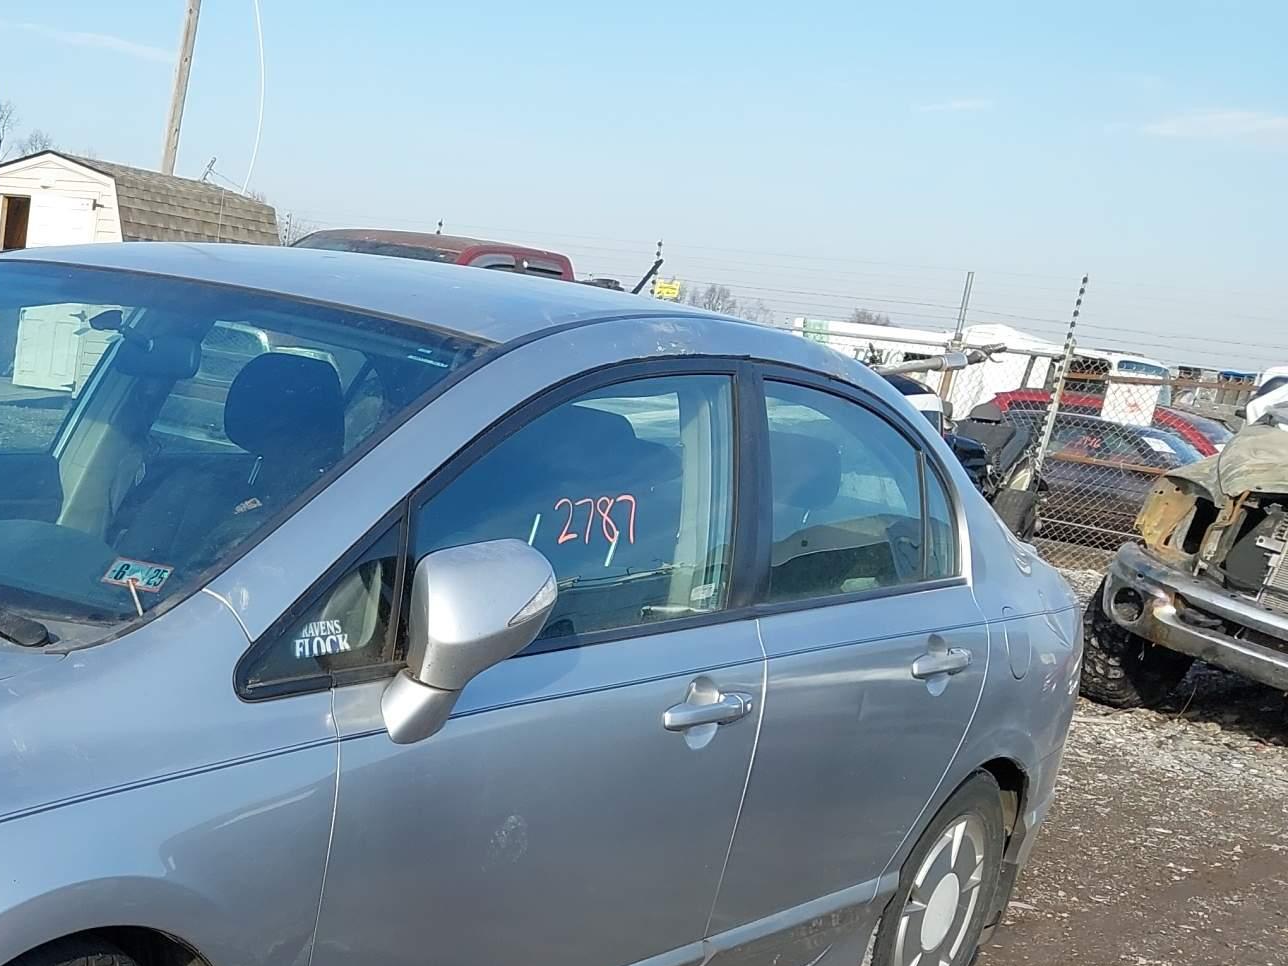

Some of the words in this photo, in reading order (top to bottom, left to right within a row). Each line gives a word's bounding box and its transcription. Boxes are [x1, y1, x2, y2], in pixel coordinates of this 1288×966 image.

[554, 494, 636, 545] 2787
[146, 568, 168, 587] 25
[301, 620, 342, 638] RAVENS
[294, 633, 352, 659] FLOCK
